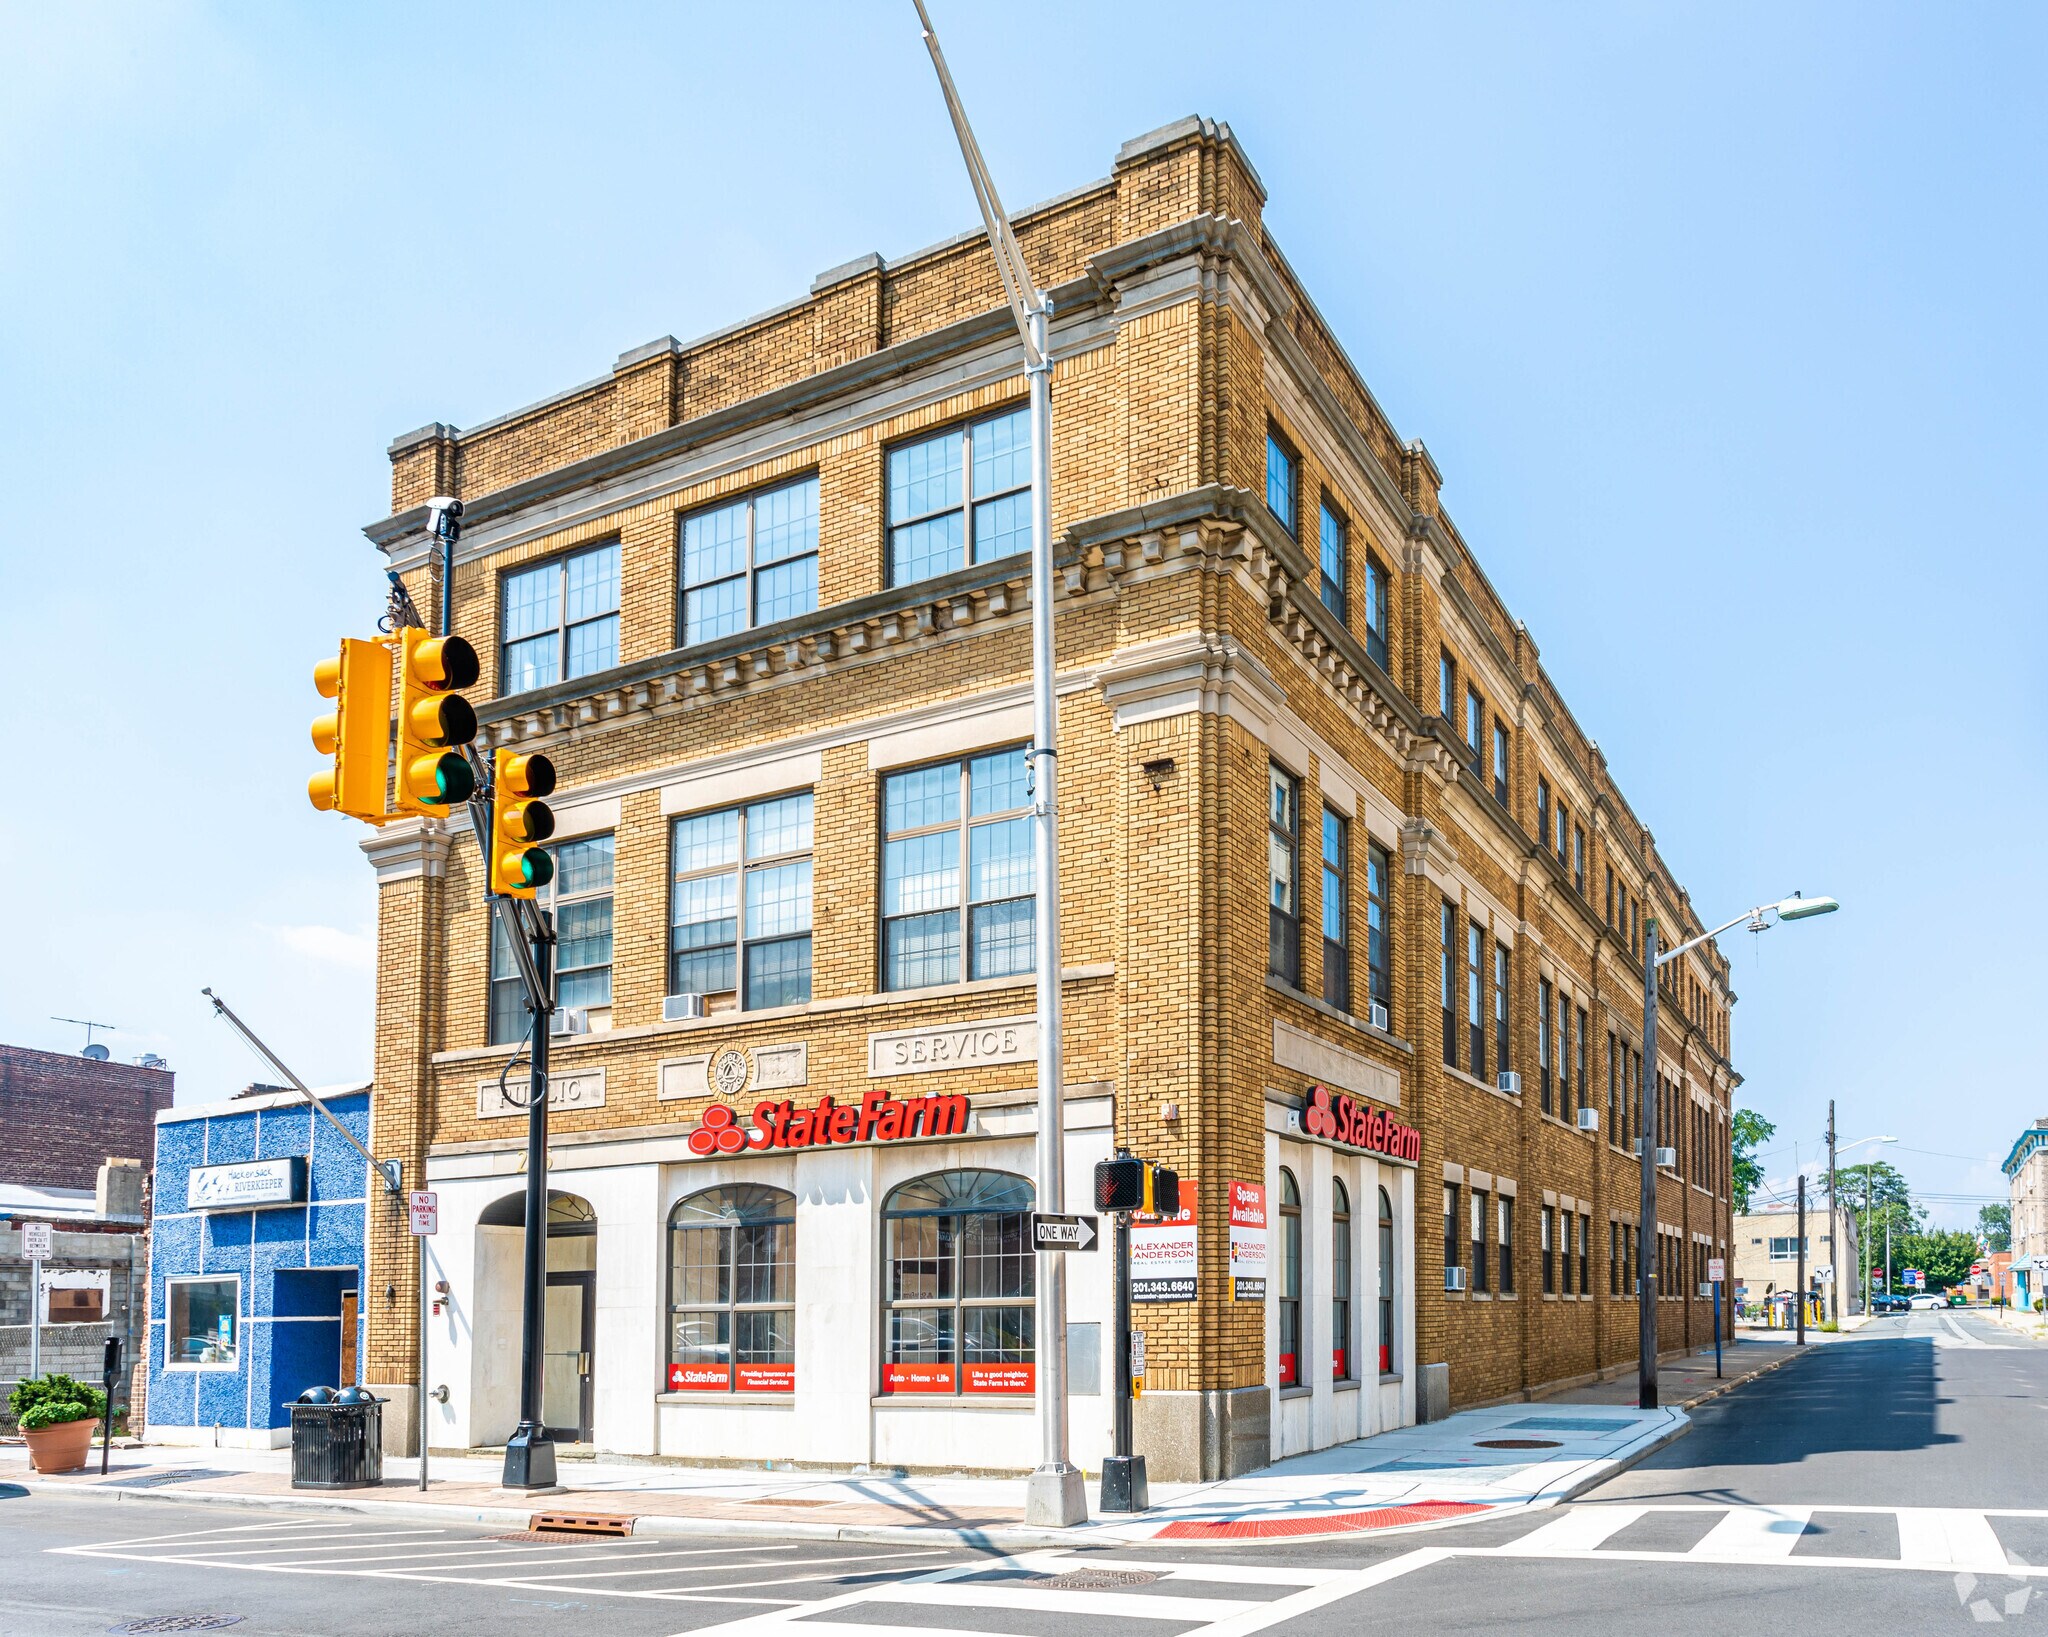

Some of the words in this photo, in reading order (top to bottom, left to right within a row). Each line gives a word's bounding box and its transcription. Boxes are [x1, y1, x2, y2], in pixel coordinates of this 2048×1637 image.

[895, 1028, 1018, 1066] SERVICE
[499, 1080, 581, 1109] PULIC
[516, 1148, 554, 1174] 25
[228, 1168, 273, 1180] Hackensack
[234, 1178, 283, 1193] RIVERKEEPER
[418, 1195, 429, 1204] NO
[1236, 1185, 1259, 1205] Space
[412, 1205, 436, 1214] PARKING
[1232, 1205, 1264, 1224] Available
[1040, 1225, 1058, 1239] ONE
[1060, 1226, 1079, 1240] WAY
[1134, 1242, 1194, 1250] ALEXANDER
[1238, 1242, 1265, 1250] ALEXANDER
[1134, 1250, 1194, 1259] ANDERSON
[1238, 1250, 1266, 1259] ANDERSON
[1132, 1281, 1195, 1293] 201.343.6640
[740, 1370, 763, 1378] Providing
[889, 1374, 905, 1383] Auto
[910, 1374, 931, 1383] Home
[936, 1373, 950, 1382] Life
[989, 1371, 1003, 1379] good
